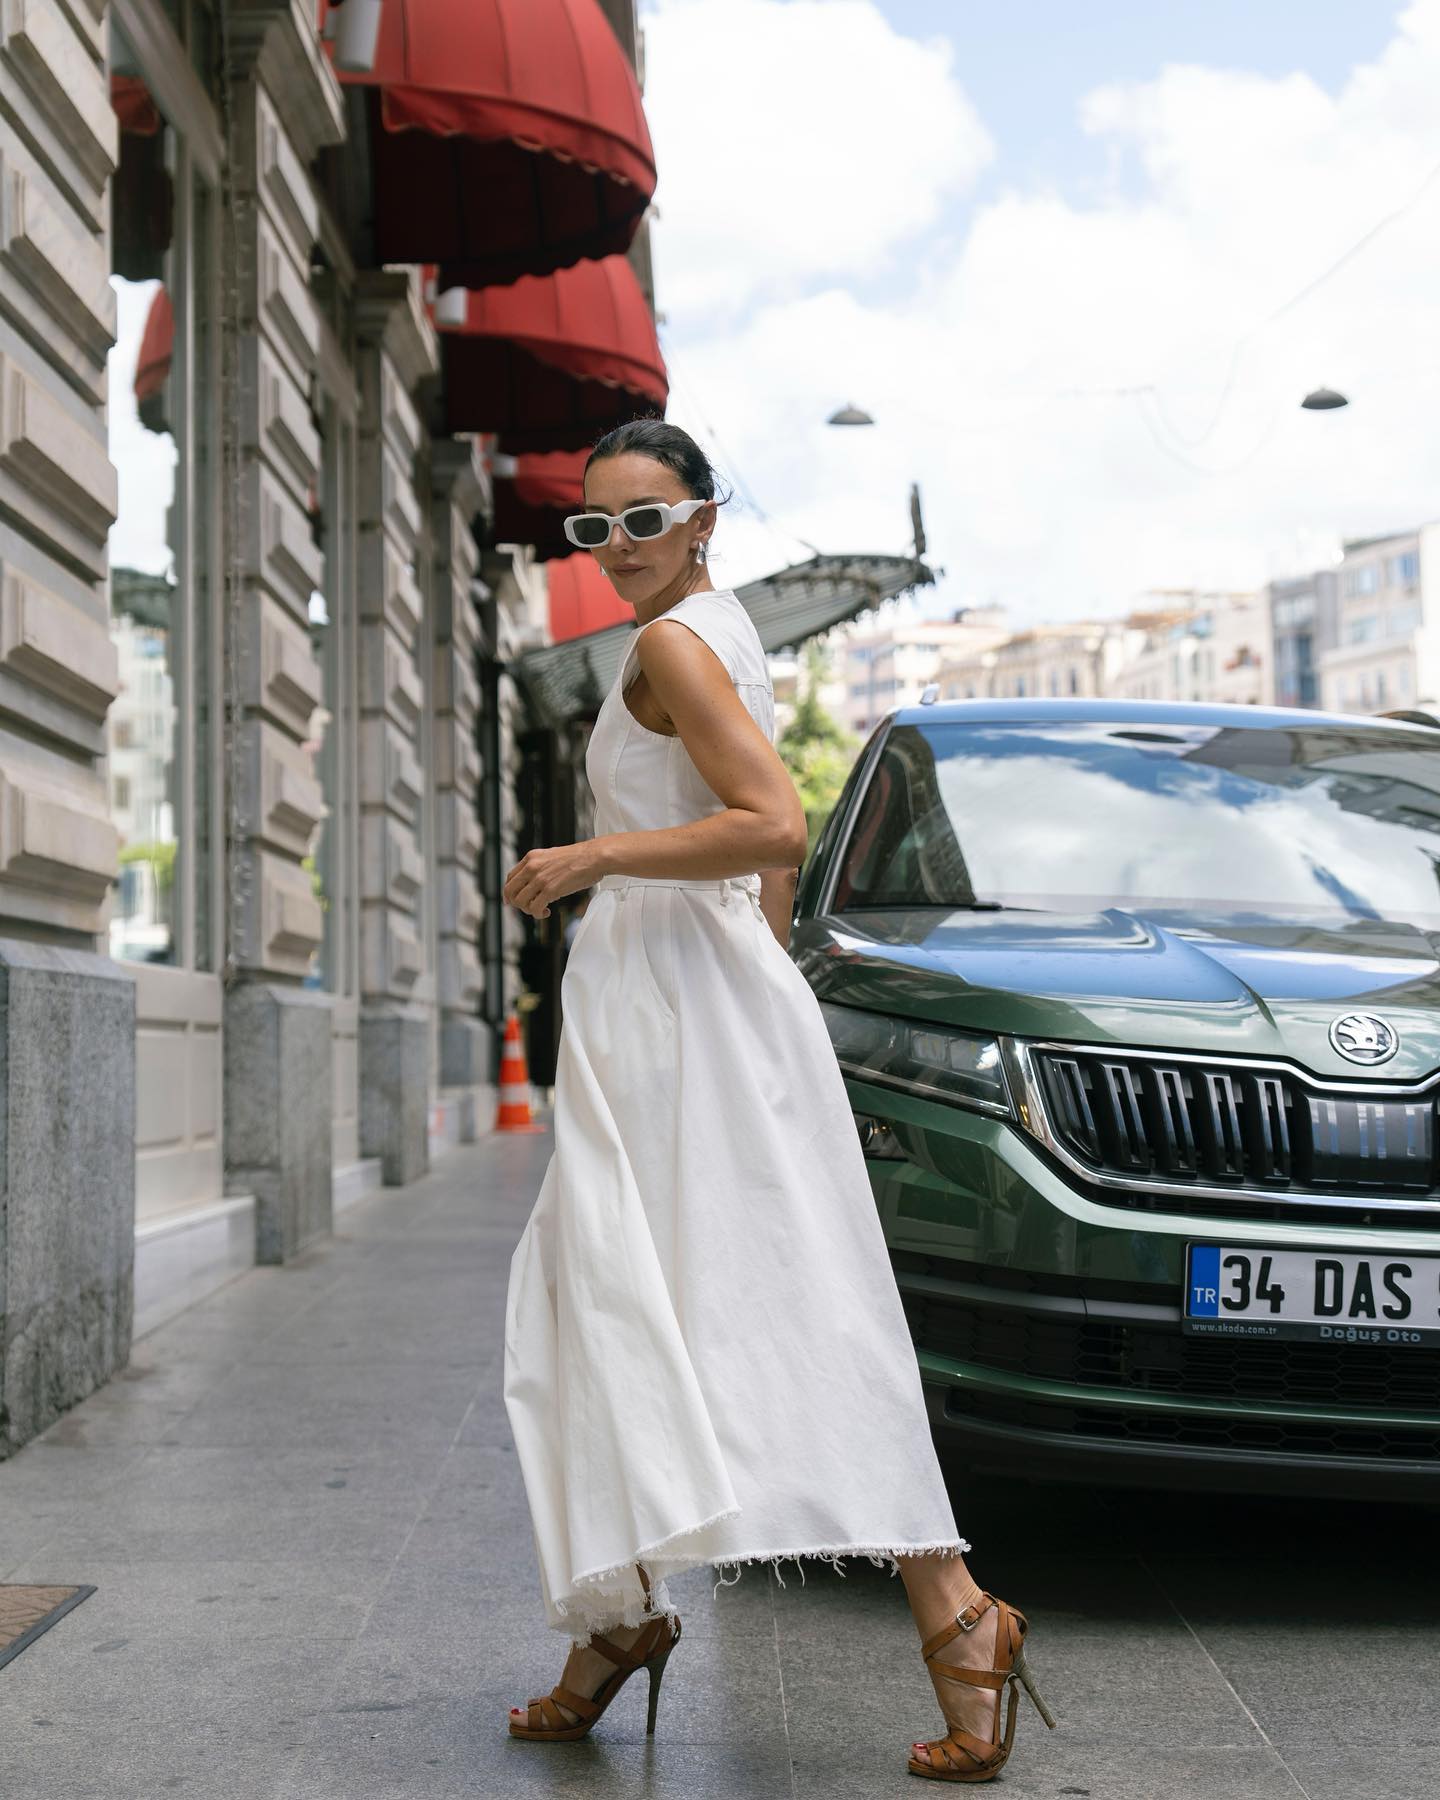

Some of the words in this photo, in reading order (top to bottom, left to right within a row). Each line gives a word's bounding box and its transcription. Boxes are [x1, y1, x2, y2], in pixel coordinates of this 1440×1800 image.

[1194, 1287, 1216, 1304] TR
[1221, 1255, 1285, 1314] 34
[1314, 1259, 1412, 1320] DAS
[1191, 1323, 1277, 1335] www.skoda.com.tr
[1320, 1326, 1381, 1342] Doğuş
[1386, 1329, 1421, 1342] Oto
